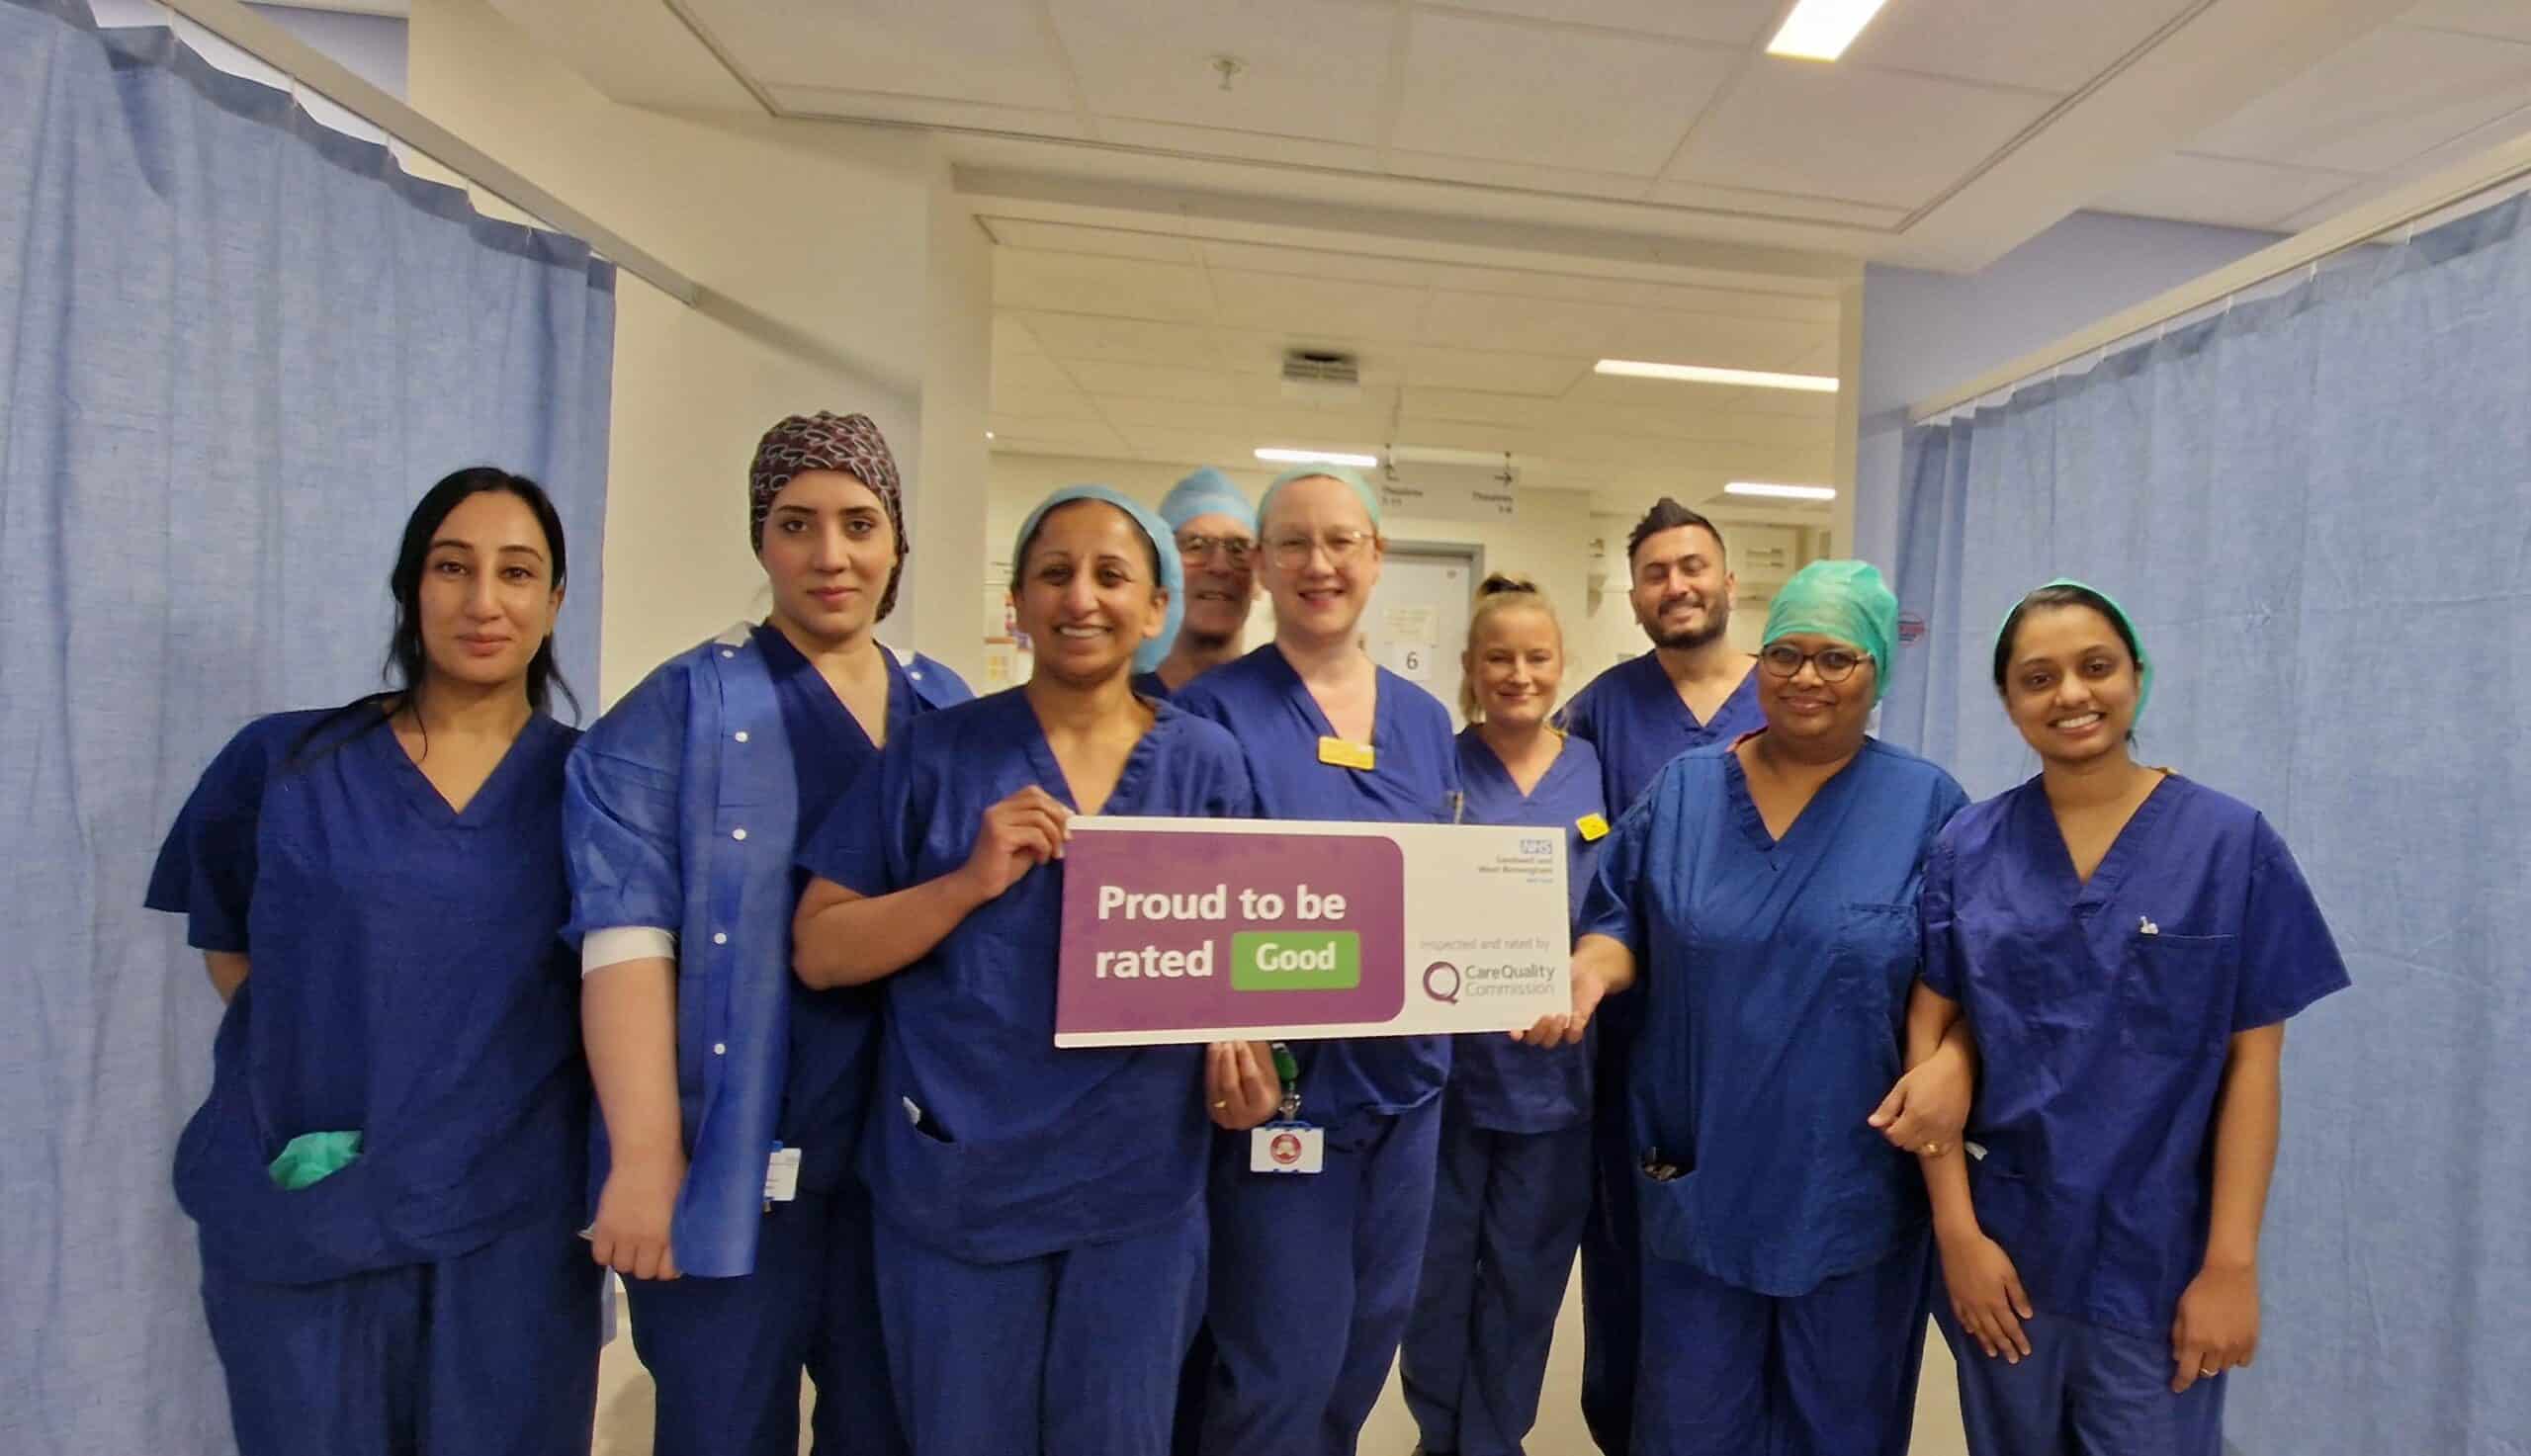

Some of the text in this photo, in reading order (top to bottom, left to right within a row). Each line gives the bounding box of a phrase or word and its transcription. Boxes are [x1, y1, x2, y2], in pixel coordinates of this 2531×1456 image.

[1406, 650, 1419, 670] 6
[1521, 839, 1551, 854] NHS
[1098, 884, 1347, 920] Proud to be
[1480, 938, 1501, 950] and
[1505, 938, 1532, 950] rated
[1535, 938, 1550, 952] by
[1095, 940, 1337, 979] rated Good
[1465, 981, 1555, 997] Commission
